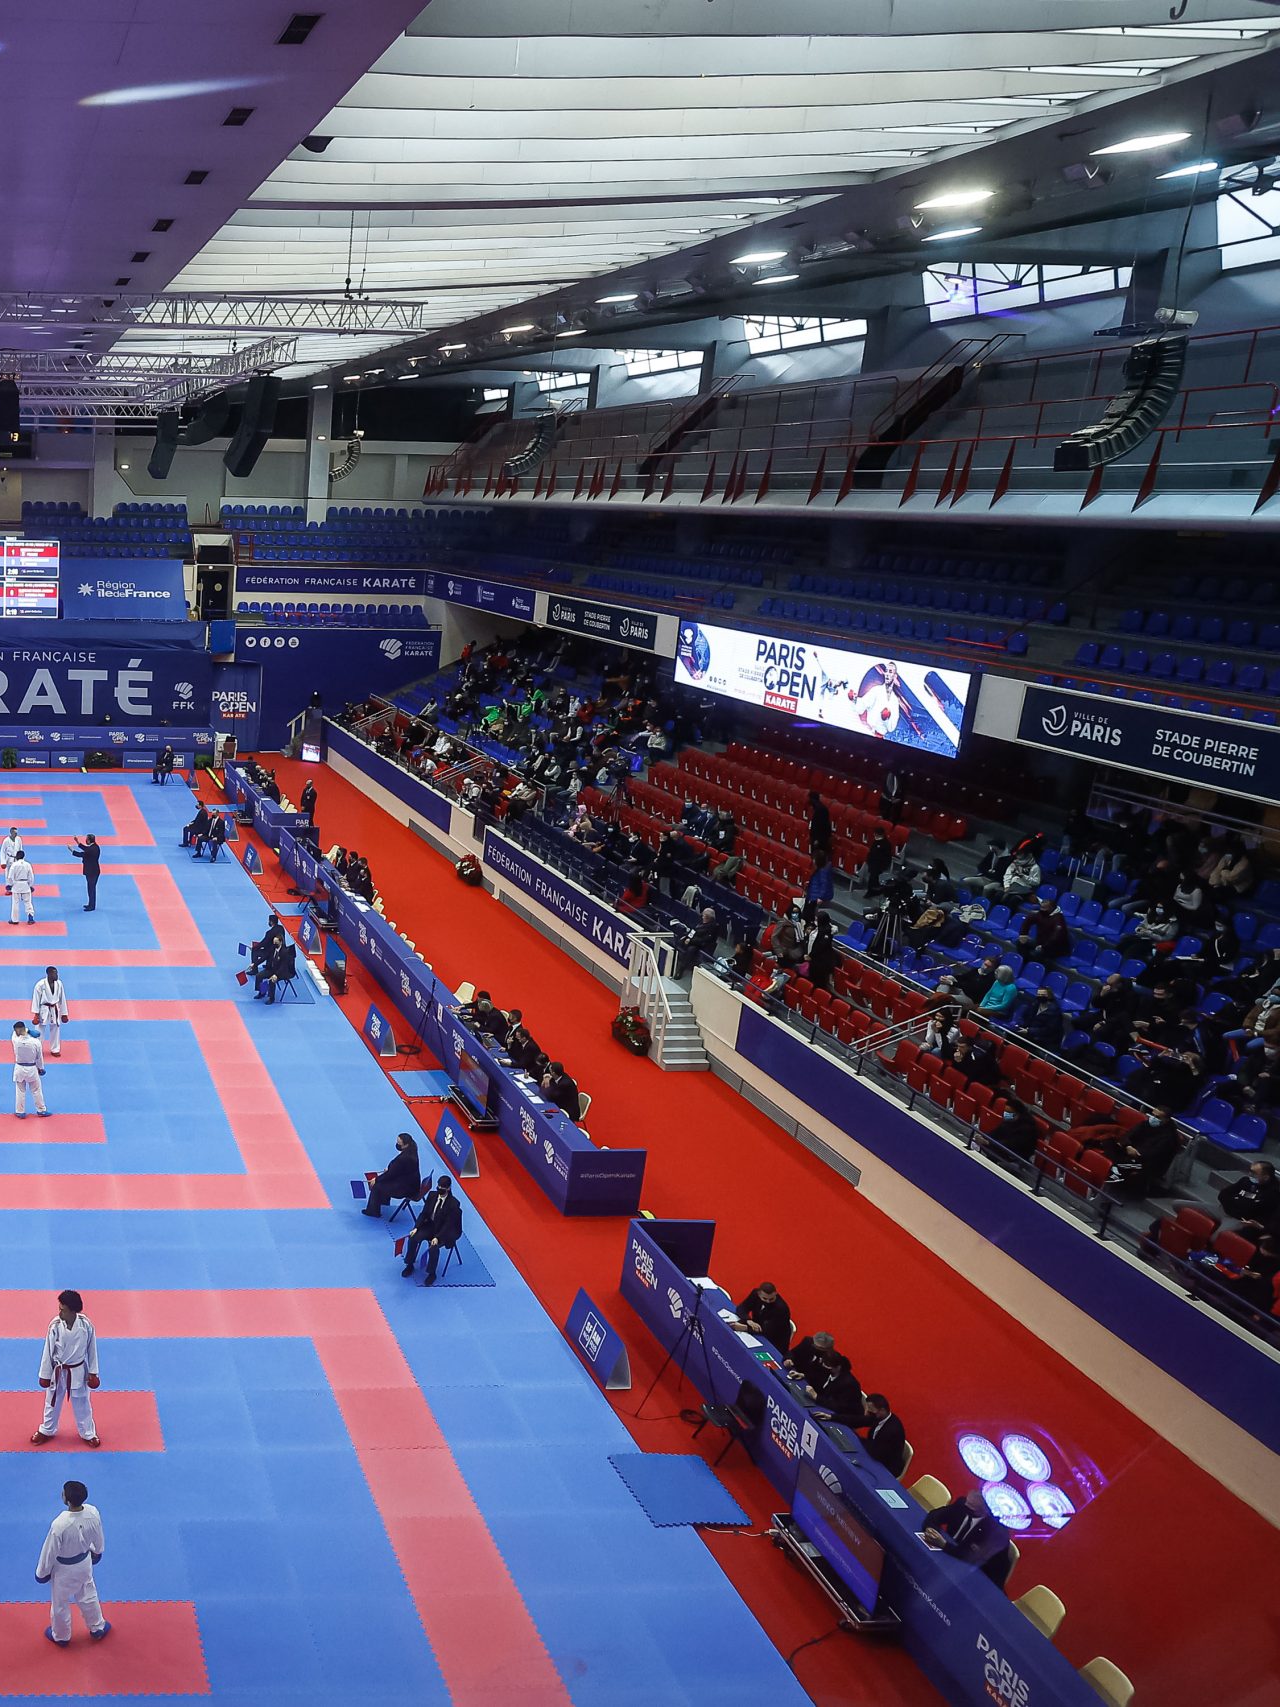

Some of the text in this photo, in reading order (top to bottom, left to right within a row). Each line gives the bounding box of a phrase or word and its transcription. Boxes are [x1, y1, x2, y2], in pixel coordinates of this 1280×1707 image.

[96, 580, 137, 591] Région
[245, 576, 300, 585] FÉDÉRATION
[304, 578, 358, 586] FRANÇAISE
[363, 576, 416, 588] KARATÉ
[560, 610, 576, 623] PARIS
[629, 626, 649, 640] PARIS
[13, 651, 97, 663] FRANÇAISE
[756, 639, 806, 671] PARIS
[211, 691, 248, 702] PARIS
[764, 666, 817, 701] OPEN
[172, 701, 195, 710] FFK
[219, 701, 256, 712] OPEN
[765, 693, 797, 712] KARATE
[1073, 711, 1108, 724] VILLE DE
[1070, 720, 1122, 746] PARIS
[1155, 729, 1259, 760] STADE PIERRE
[1152, 743, 1256, 777] DE COUBERTIN
[488, 845, 532, 886] FÉDÉRATION
[535, 878, 589, 927] FRANÇAISE
[520, 1106, 536, 1131] PARIS
[521, 1119, 538, 1145] OPEN
[632, 1238, 654, 1270] PARIS
[634, 1255, 659, 1290] OPEN
[767, 1395, 798, 1438] PARIS
[771, 1417, 804, 1459] OPEN
[771, 1432, 791, 1460] KARATE
[806, 1433, 811, 1447] 1
[976, 1633, 1030, 1701] PARIS
[984, 1663, 1029, 1707] OPE
